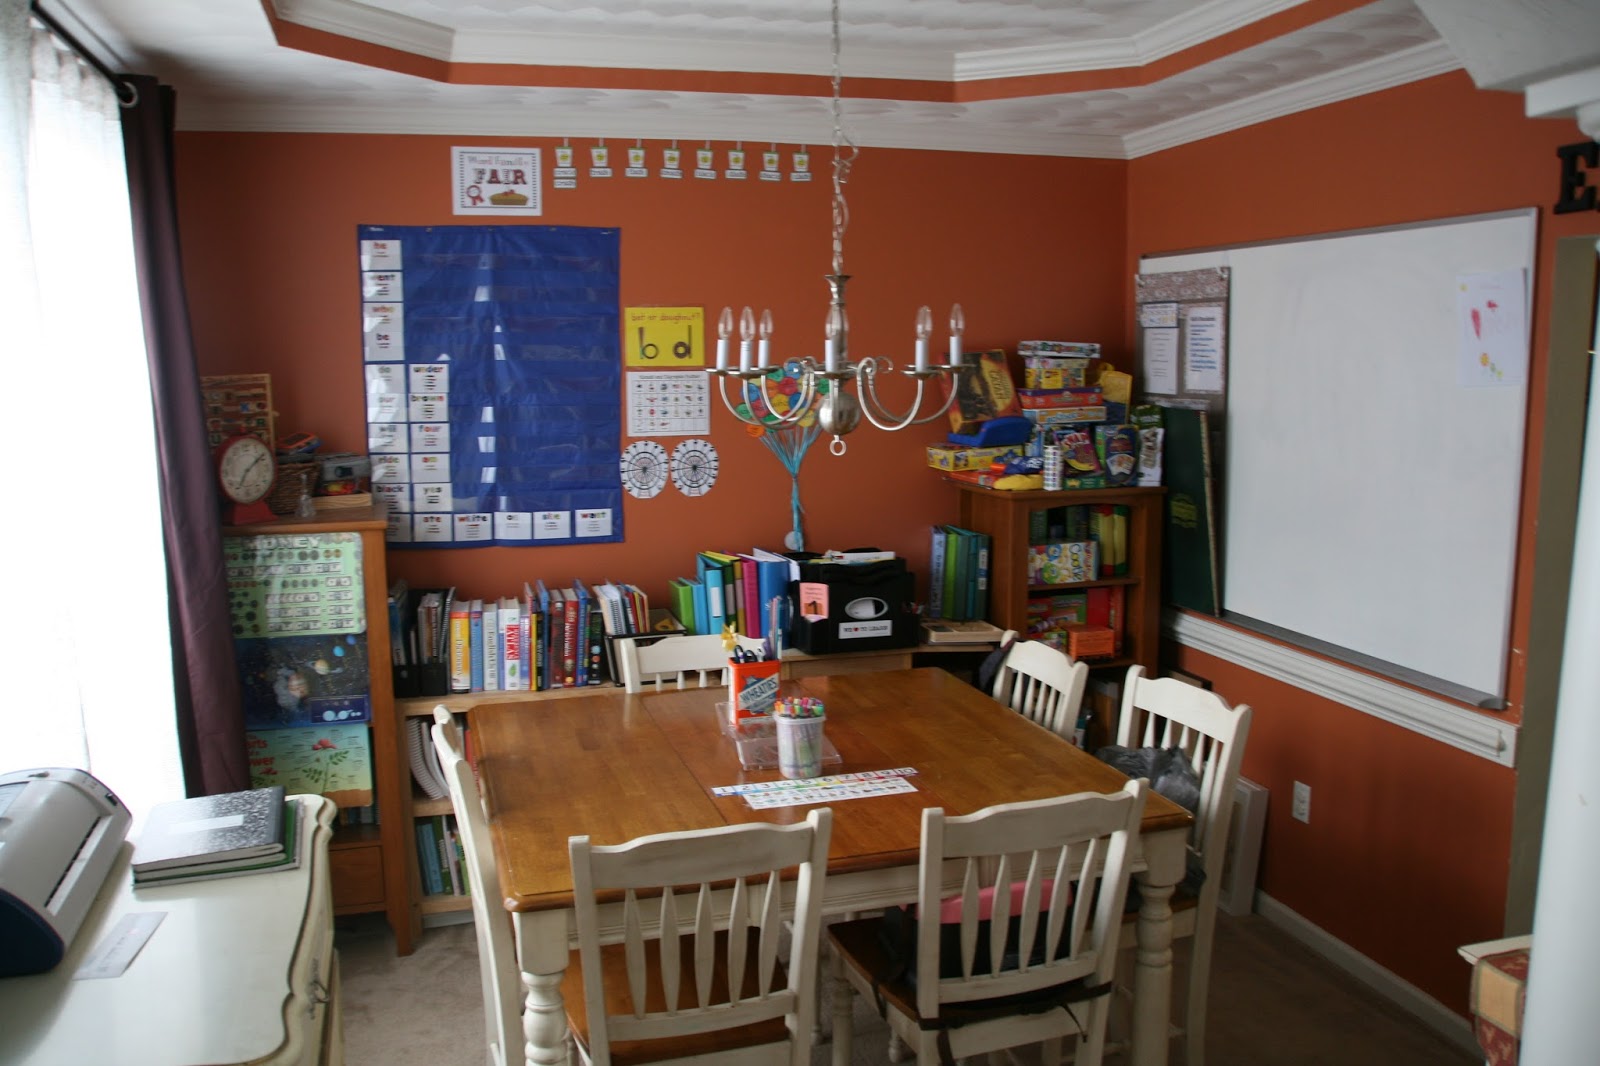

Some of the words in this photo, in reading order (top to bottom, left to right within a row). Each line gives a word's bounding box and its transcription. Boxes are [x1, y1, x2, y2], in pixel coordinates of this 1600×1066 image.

[472, 168, 527, 184] FAIR
[1553, 142, 1600, 215] E
[376, 485, 404, 493] black
[423, 485, 442, 495] yes
[422, 515, 442, 523] ate
[457, 514, 487, 522] white
[242, 537, 321, 550] MONEY
[505, 629, 515, 660] ATLAS
[739, 677, 778, 703] WHEATIES
